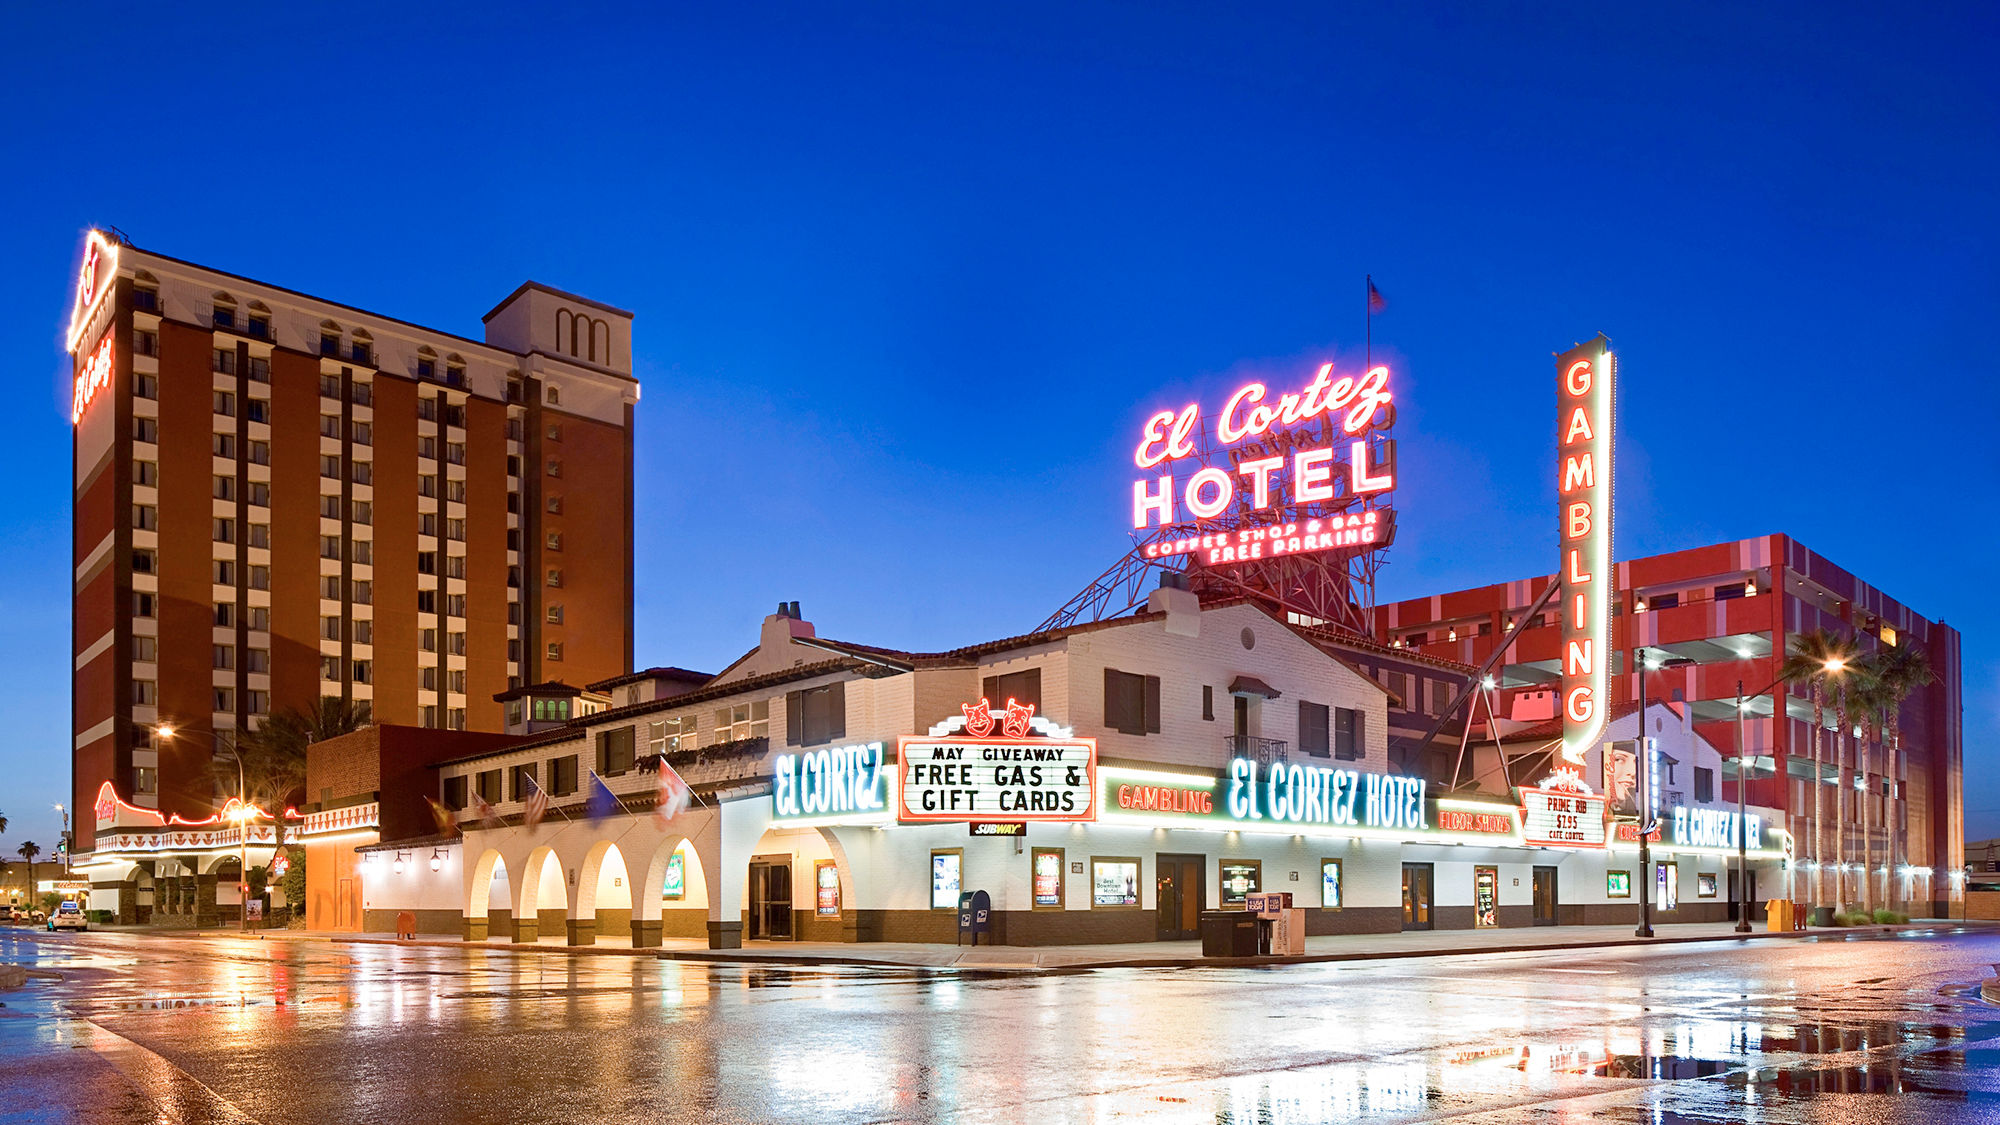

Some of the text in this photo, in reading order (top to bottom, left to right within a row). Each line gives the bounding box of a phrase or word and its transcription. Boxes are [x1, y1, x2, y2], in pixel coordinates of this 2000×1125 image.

[1134, 404, 1198, 468] El
[1218, 363, 1392, 444] Cortez
[1134, 440, 1392, 529] HOTEL
[1147, 512, 1377, 558] COFFEE SHOP & BAR
[1210, 526, 1376, 564] FREE PARKING
[1564, 359, 1595, 723] GAMBLING
[932, 747, 1065, 762] MAY GIVEAWAY
[776, 742, 884, 816] EL CORTEZ
[914, 764, 1081, 787] FREE GAS &
[922, 789, 1074, 812] GIFT CARDS
[1117, 783, 1213, 815] GAMBLING
[1230, 757, 1429, 830] EL CORTEZ HOTEL
[1547, 797, 1571, 813] PRIME
[974, 823, 1021, 835] SUBWAY
[1438, 810, 1512, 834] FLOOR SHOWS
[1564, 831, 1585, 841] CORTEZ
[1690, 807, 1730, 847] CORTEZ
[1731, 811, 1762, 849] HTEL
